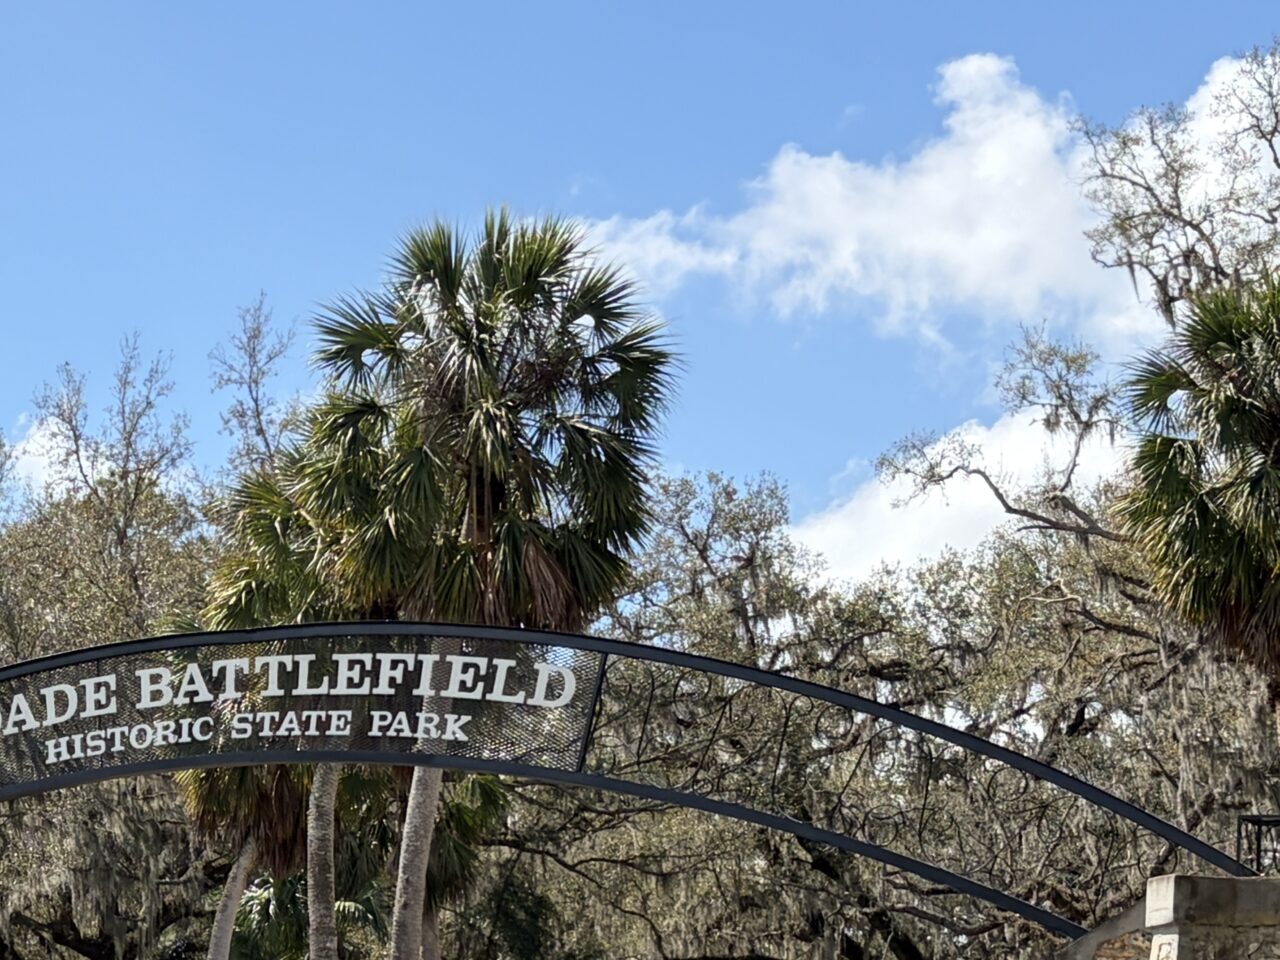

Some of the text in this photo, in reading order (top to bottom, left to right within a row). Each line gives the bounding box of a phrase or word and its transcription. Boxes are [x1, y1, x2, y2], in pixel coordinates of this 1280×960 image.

[135, 652, 576, 710] BATTLEFIELD
[45, 710, 473, 765] HISTORIC STATE PARK
